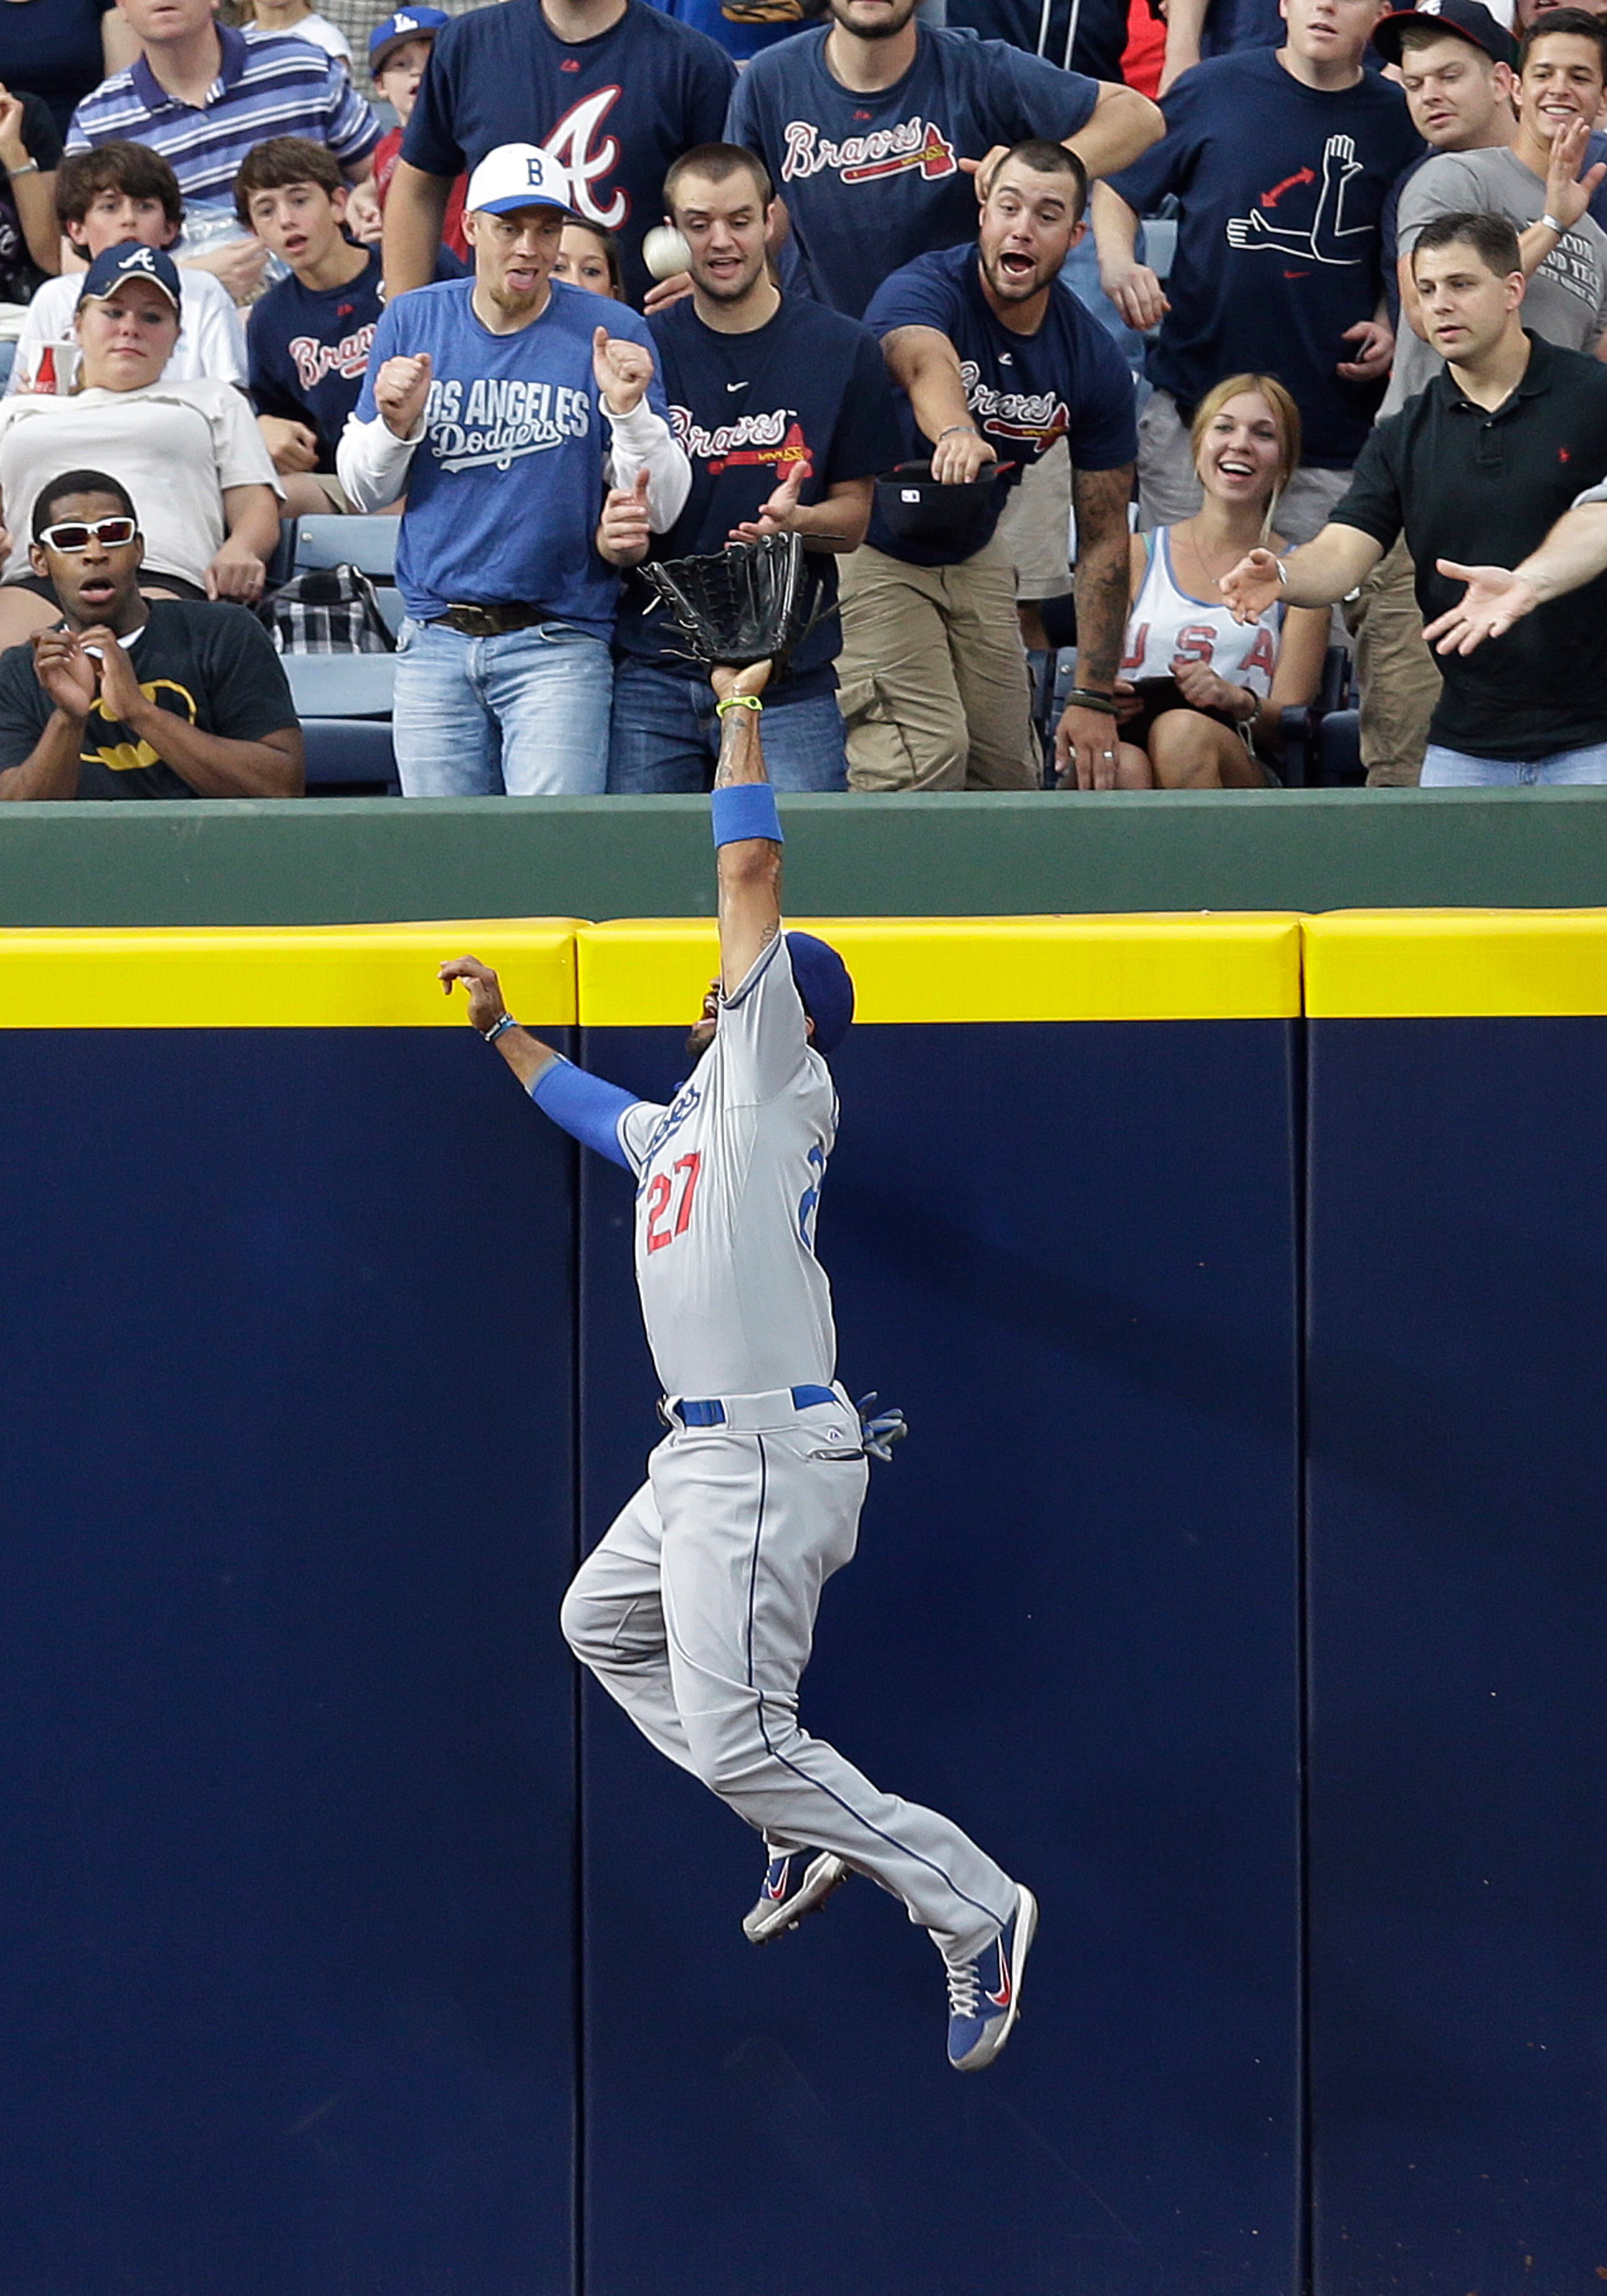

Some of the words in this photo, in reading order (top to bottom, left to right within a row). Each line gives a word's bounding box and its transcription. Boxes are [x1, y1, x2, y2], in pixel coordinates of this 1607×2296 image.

[526, 158, 544, 186] B
[539, 85, 633, 230] A
[781, 116, 922, 183] Braves
[118, 248, 155, 271] A
[289, 323, 377, 391] Brav
[427, 379, 462, 426] OS
[464, 379, 590, 438] ANGELES
[429, 418, 563, 473] Dodgers
[1121, 623, 1275, 677] USA
[647, 1151, 701, 1256] 27
